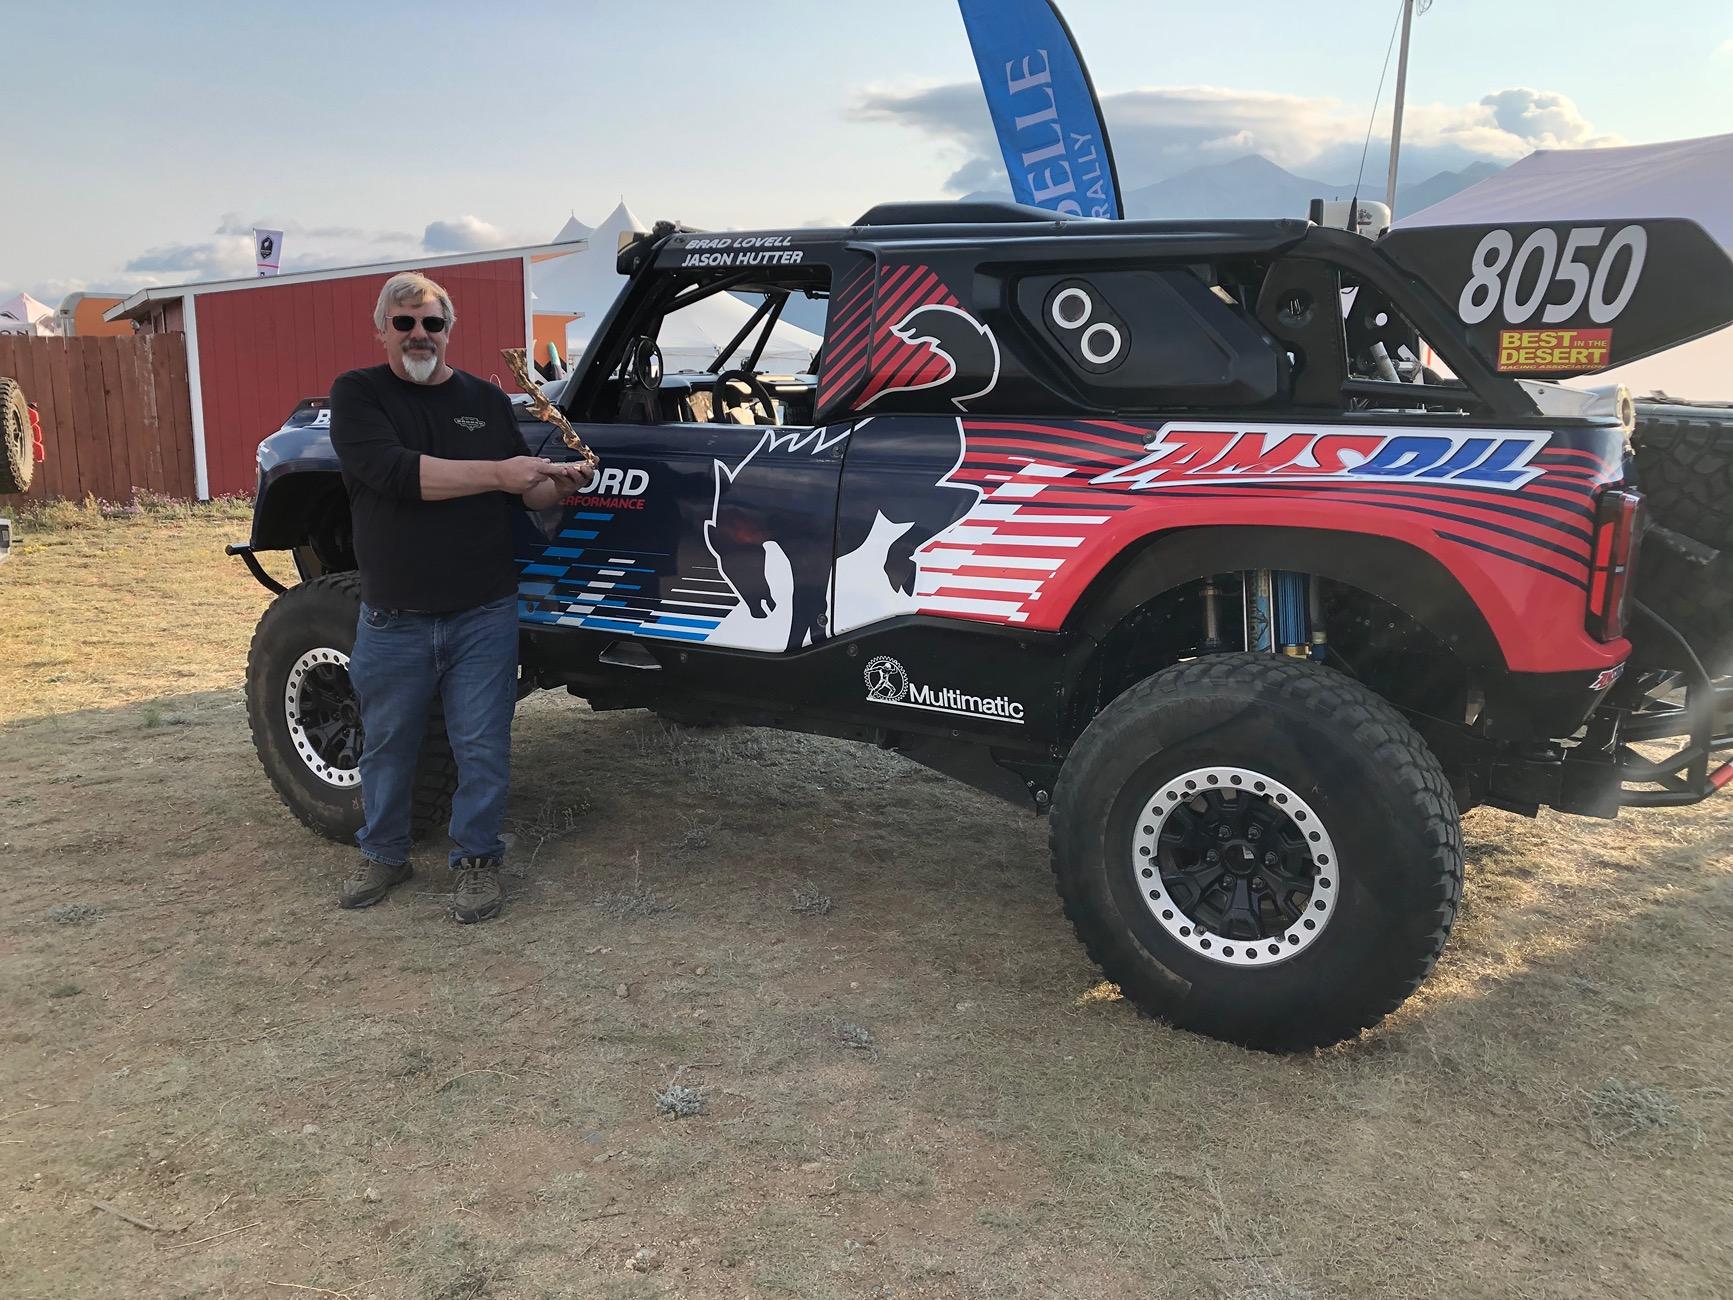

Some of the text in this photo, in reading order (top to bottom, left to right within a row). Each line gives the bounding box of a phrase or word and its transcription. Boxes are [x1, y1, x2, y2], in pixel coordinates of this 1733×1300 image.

[1070, 132, 1111, 219] RALLY
[685, 236, 792, 250] BRAD LOVELL
[681, 250, 804, 267] JASON HUTTER
[1458, 225, 1648, 324] 8050
[1502, 331, 1578, 348] BEST
[1500, 348, 1607, 364] DESERT
[1095, 426, 1547, 489] AMSOIL
[577, 467, 650, 496] ORD
[559, 495, 646, 510] ERFORMANCE
[908, 682, 1025, 719] Multimatic
